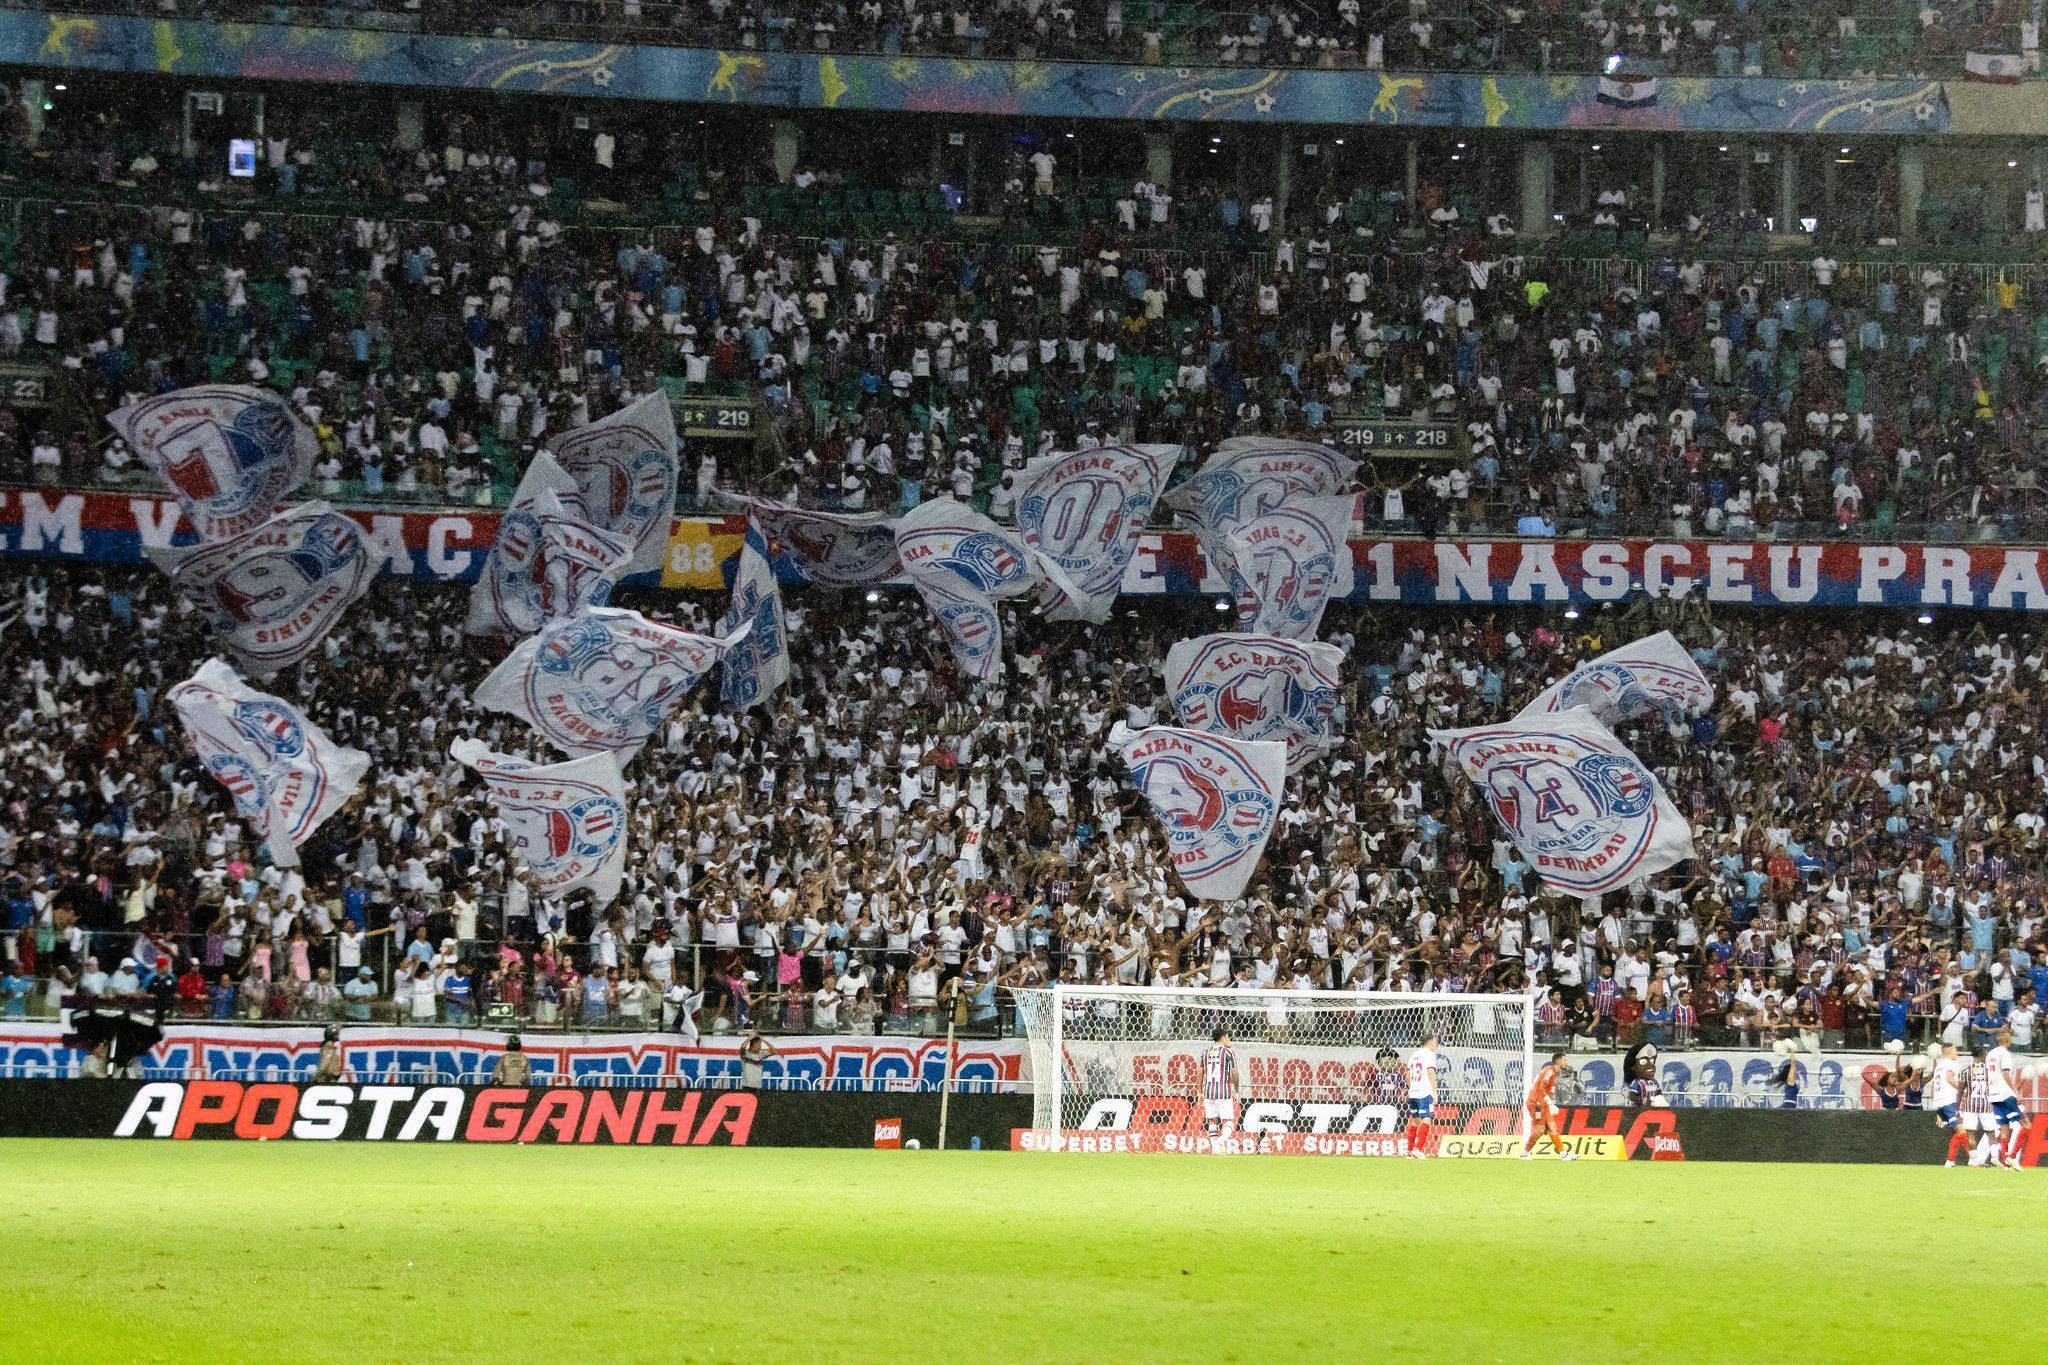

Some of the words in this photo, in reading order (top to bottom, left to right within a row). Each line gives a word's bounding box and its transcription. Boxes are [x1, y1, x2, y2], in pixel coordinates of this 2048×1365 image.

[718, 410, 750, 426] 219
[1342, 429, 1374, 445] 219
[1415, 430, 1448, 445] 218
[1433, 543, 1823, 602] NASCEU
[1856, 546, 2048, 608] PRA
[255, 585, 342, 644] SINISTRO
[1214, 651, 1247, 673] E.C.
[1537, 833, 1628, 872] BERIMBAU
